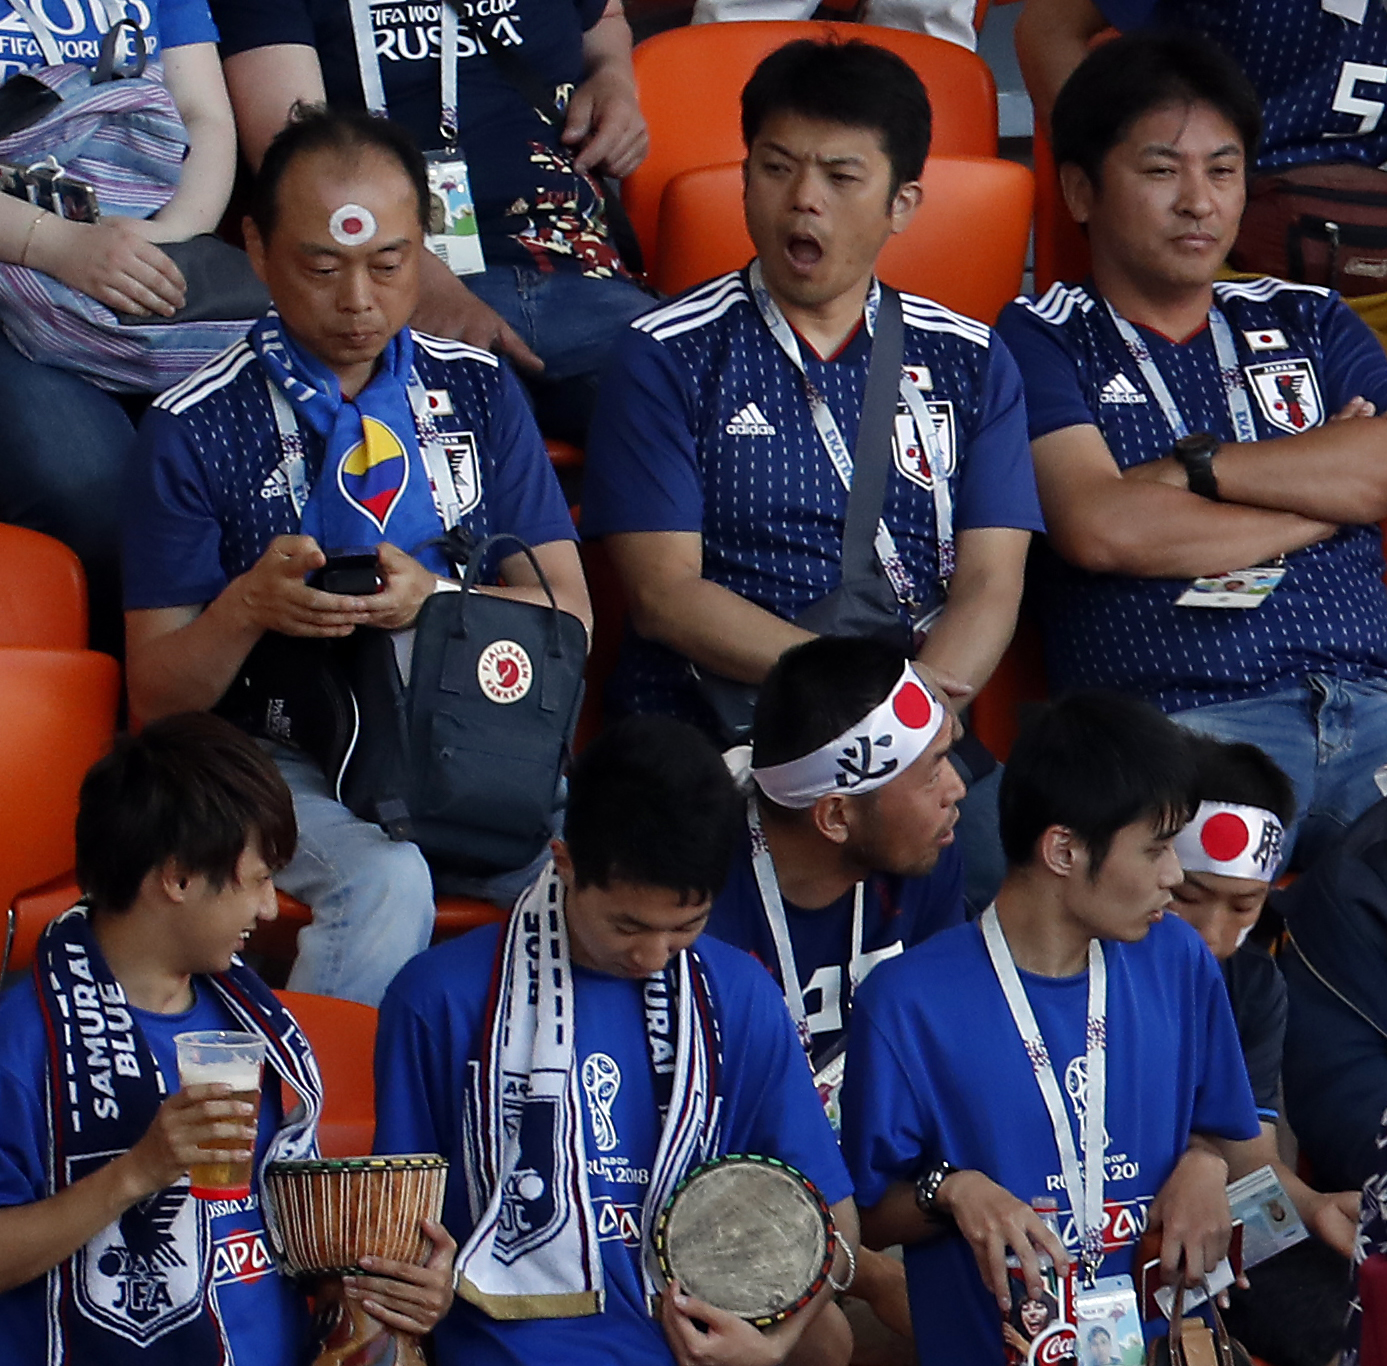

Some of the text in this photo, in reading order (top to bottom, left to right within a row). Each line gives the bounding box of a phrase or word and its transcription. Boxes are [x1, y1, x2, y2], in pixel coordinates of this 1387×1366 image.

[1101, 392, 1148, 405] adidas
[725, 424, 776, 436] adidas
[836, 736, 898, 788] 必
[64, 942, 118, 1120] SAMURAI
[97, 982, 141, 1079] BLUE
[615, 1167, 649, 1185] 2018
[112, 1281, 172, 1309] JFA
